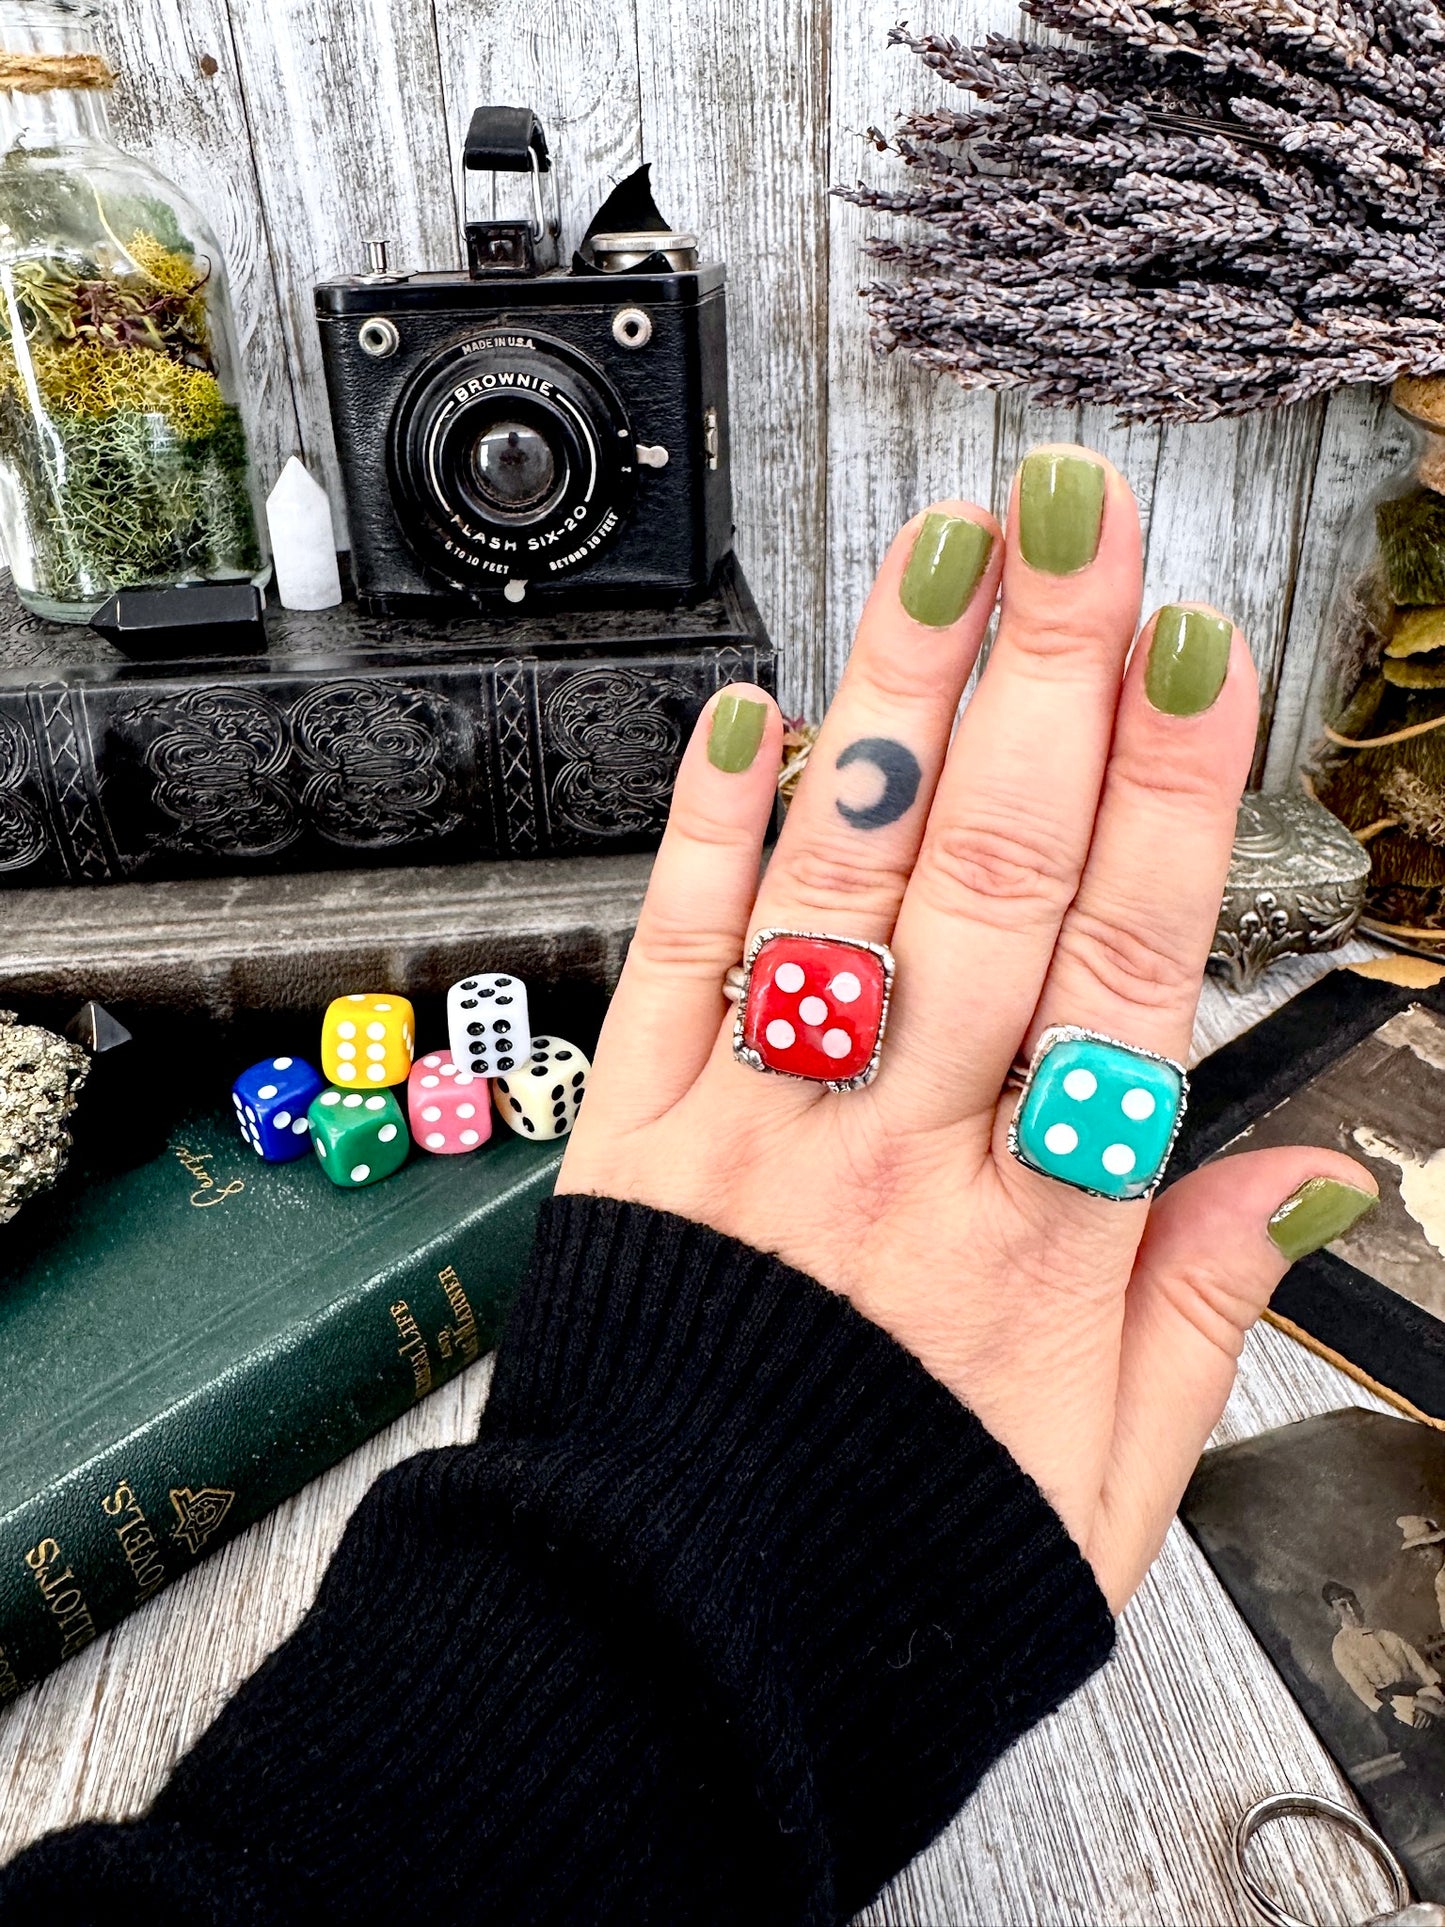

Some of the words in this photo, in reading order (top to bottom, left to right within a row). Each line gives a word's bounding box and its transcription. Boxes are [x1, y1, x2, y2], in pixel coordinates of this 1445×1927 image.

[461, 338, 493, 355] MADE
[494, 337, 506, 347] IN
[454, 372, 553, 402] BROWNIE
[527, 505, 587, 551] SIX-20
[549, 546, 588, 571] BEYOND
[587, 535, 601, 549] 10
[598, 512, 619, 537] FEET
[453, 546, 466, 559] TO
[482, 560, 509, 574] FEET
